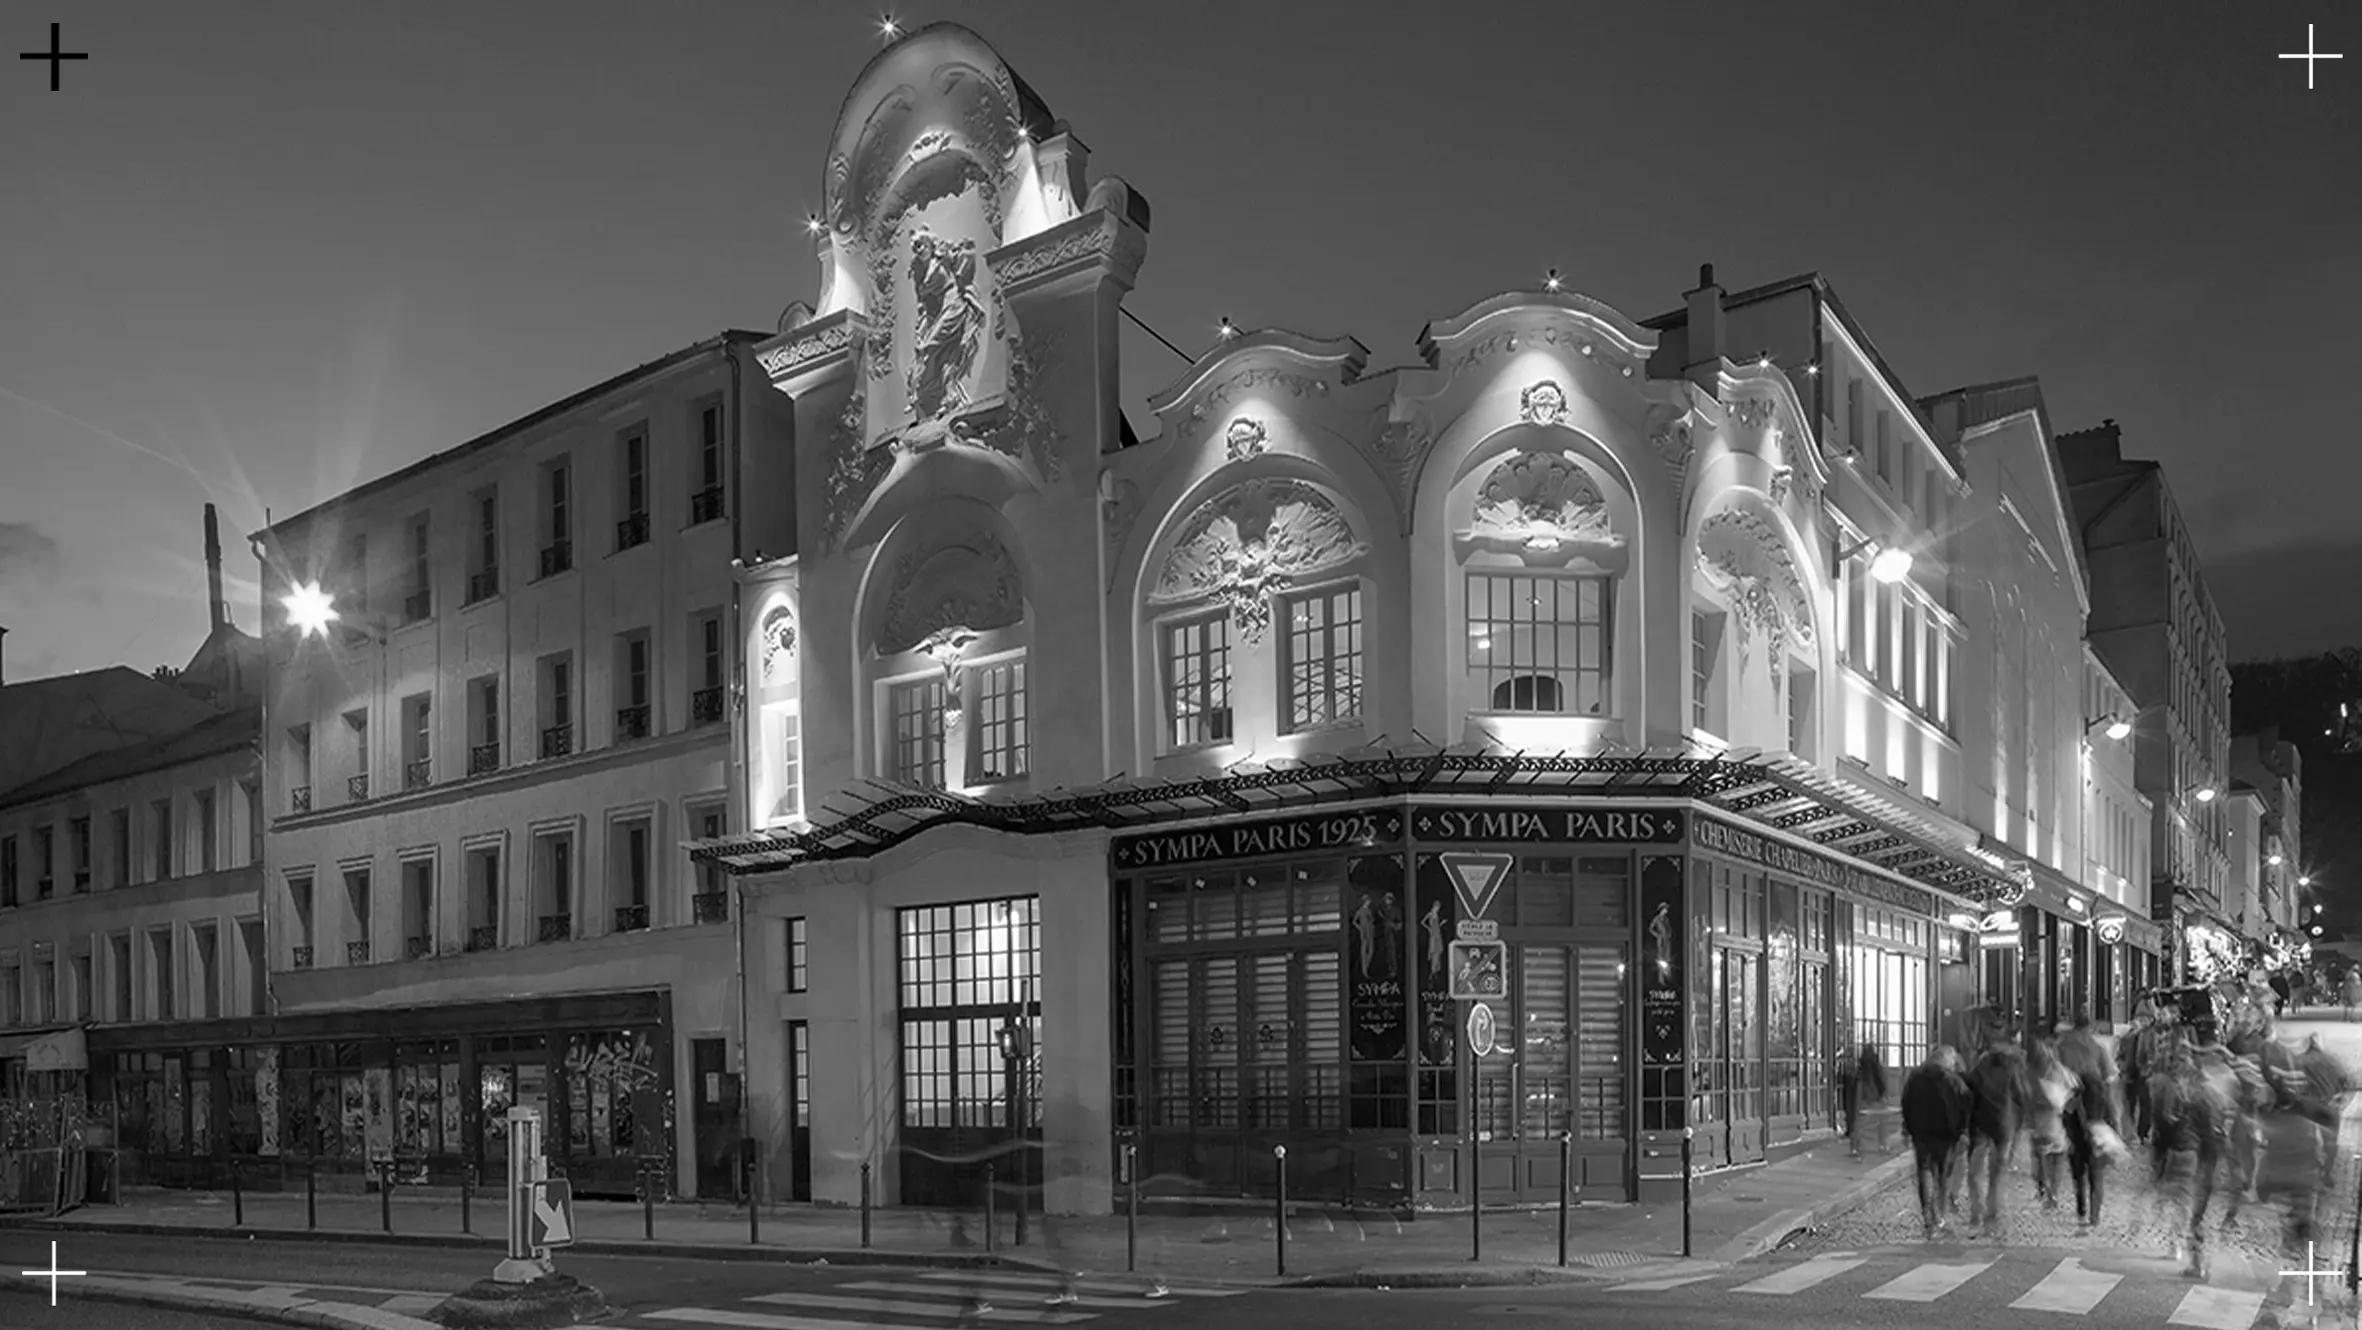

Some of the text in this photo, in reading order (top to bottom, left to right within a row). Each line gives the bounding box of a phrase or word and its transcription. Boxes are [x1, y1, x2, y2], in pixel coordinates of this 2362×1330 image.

[1134, 815, 1378, 864] SYMPA PARIS 1925
[1439, 811, 1655, 839] SYMPA PARIS
